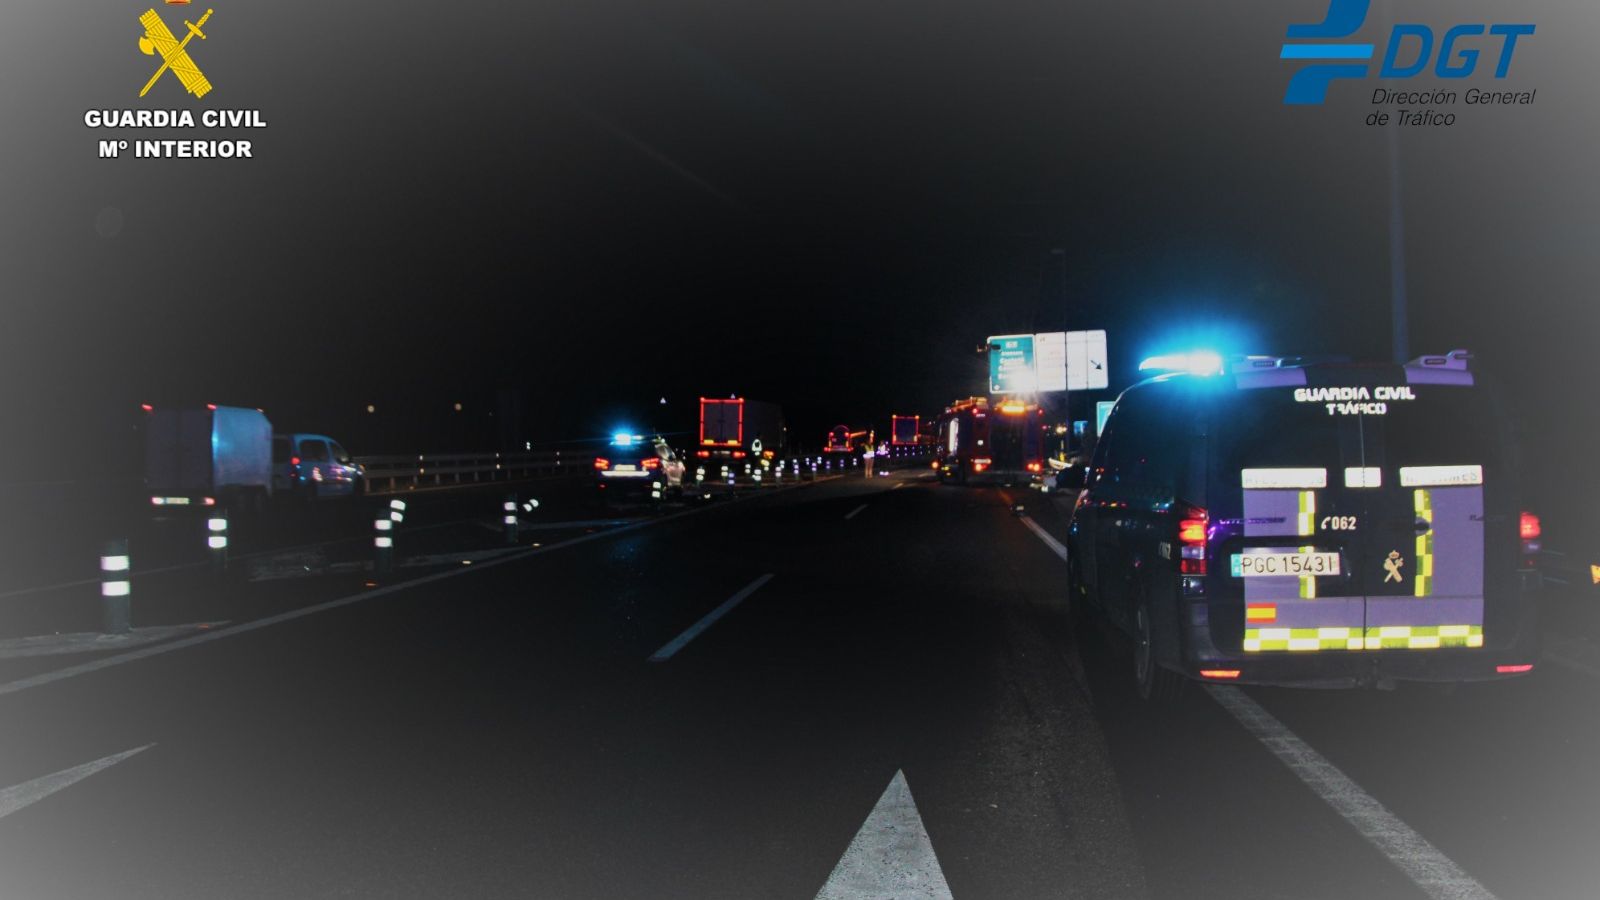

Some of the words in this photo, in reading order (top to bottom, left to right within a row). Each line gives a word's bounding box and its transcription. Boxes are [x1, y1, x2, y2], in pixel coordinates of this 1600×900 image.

[1294, 387, 1370, 402] GUARDIA
[1374, 386, 1416, 400] CIVIL
[1331, 516, 1357, 530] 062
[1241, 556, 1276, 573] PGC
